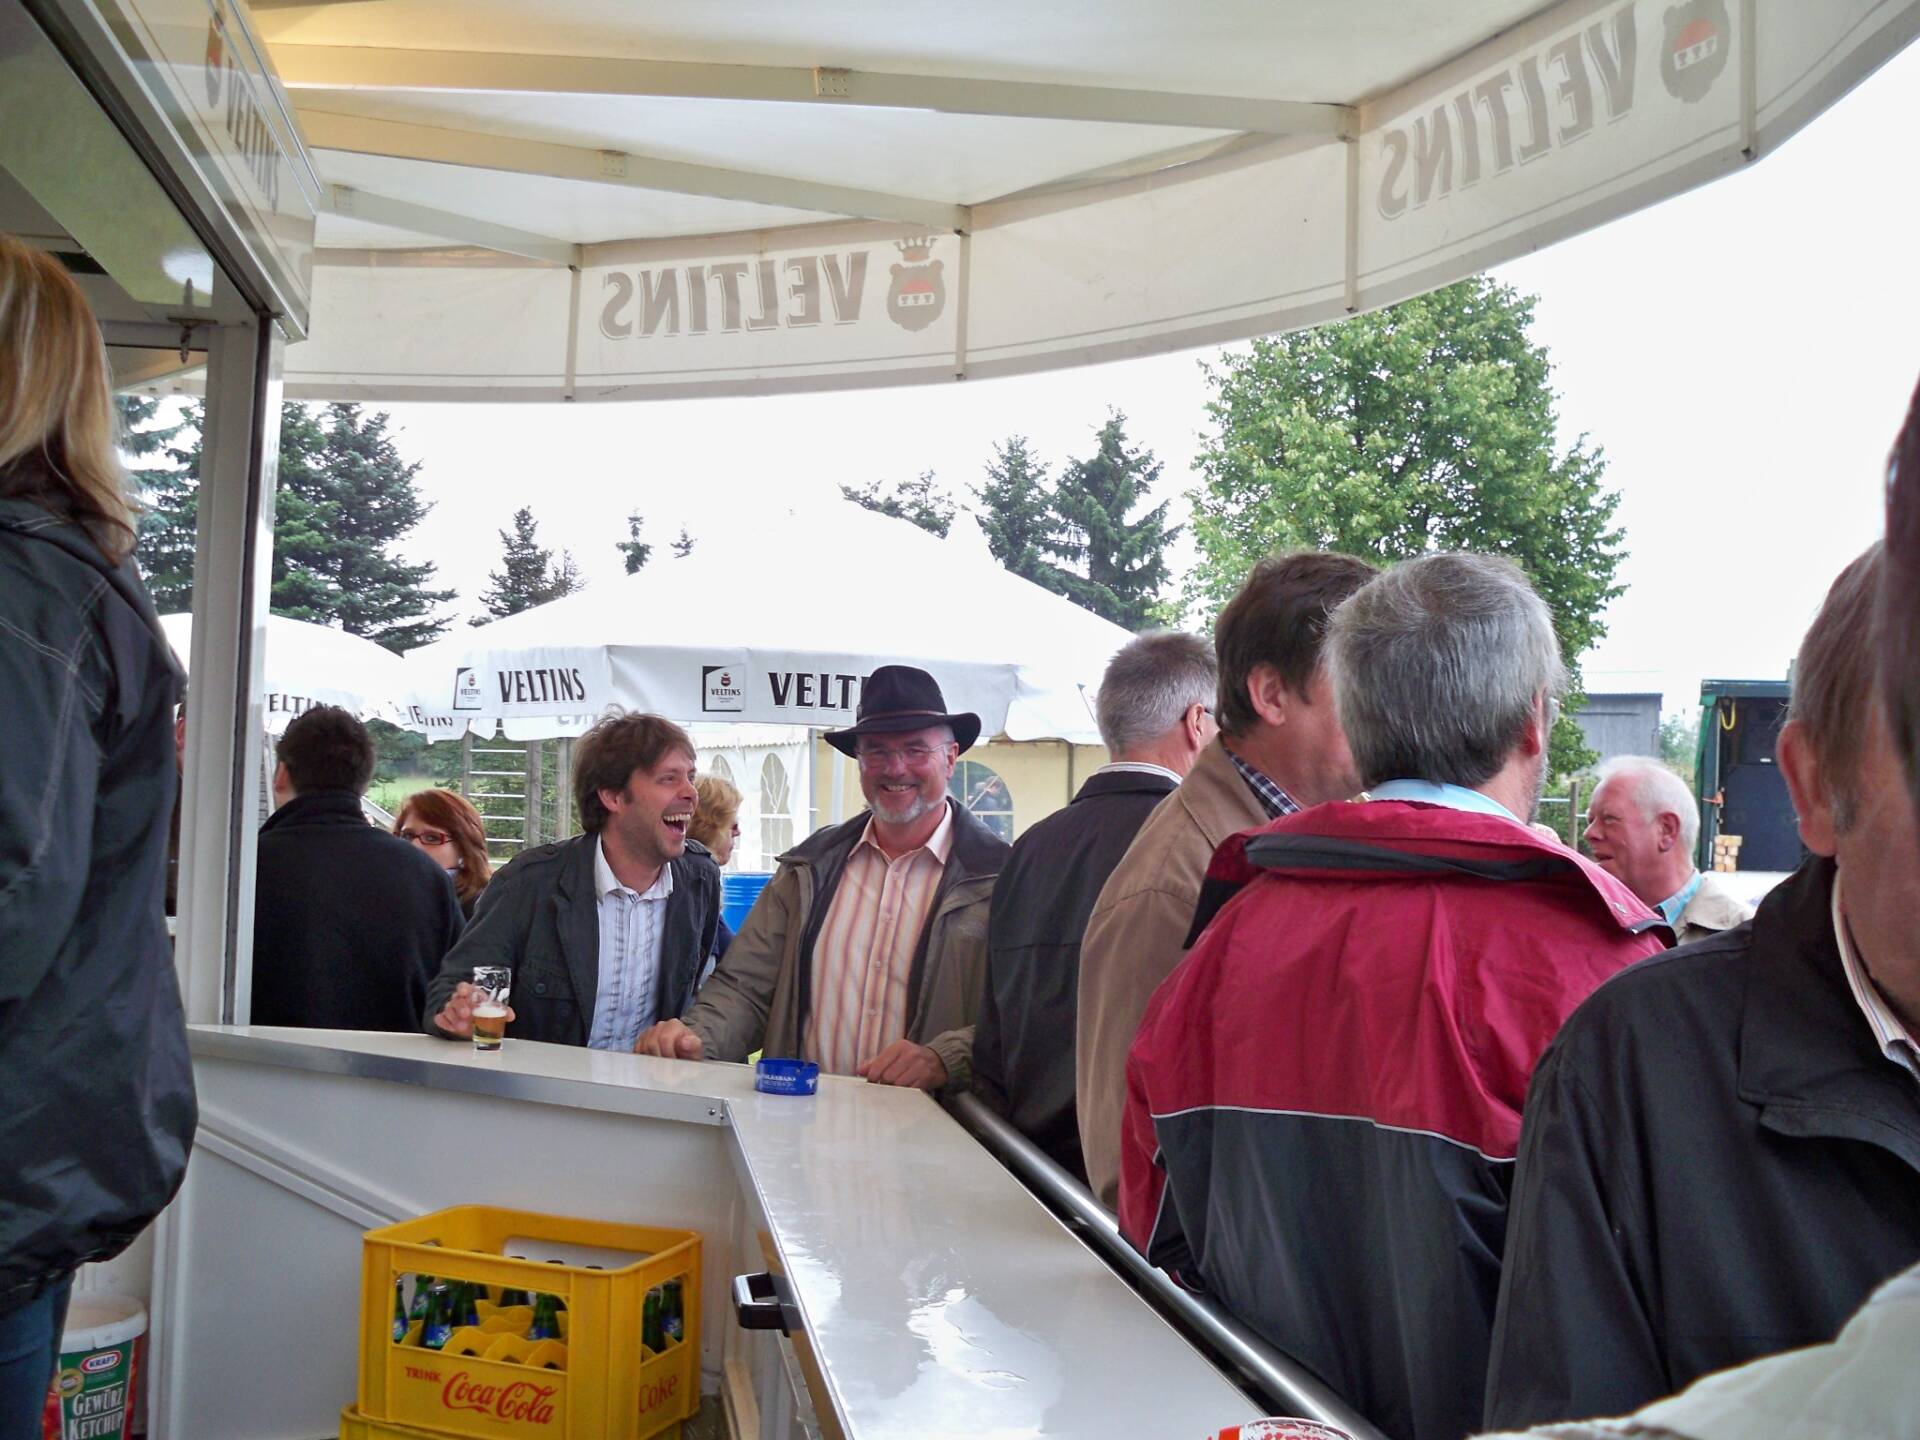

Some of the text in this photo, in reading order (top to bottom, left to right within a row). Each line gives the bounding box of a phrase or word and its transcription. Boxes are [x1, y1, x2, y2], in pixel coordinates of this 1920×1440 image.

[499, 668, 586, 703] VELTINS
[710, 688, 742, 697] VELTINS
[405, 1366, 559, 1425] TRINK Coca-Cola
[638, 1374, 678, 1415] Coke
